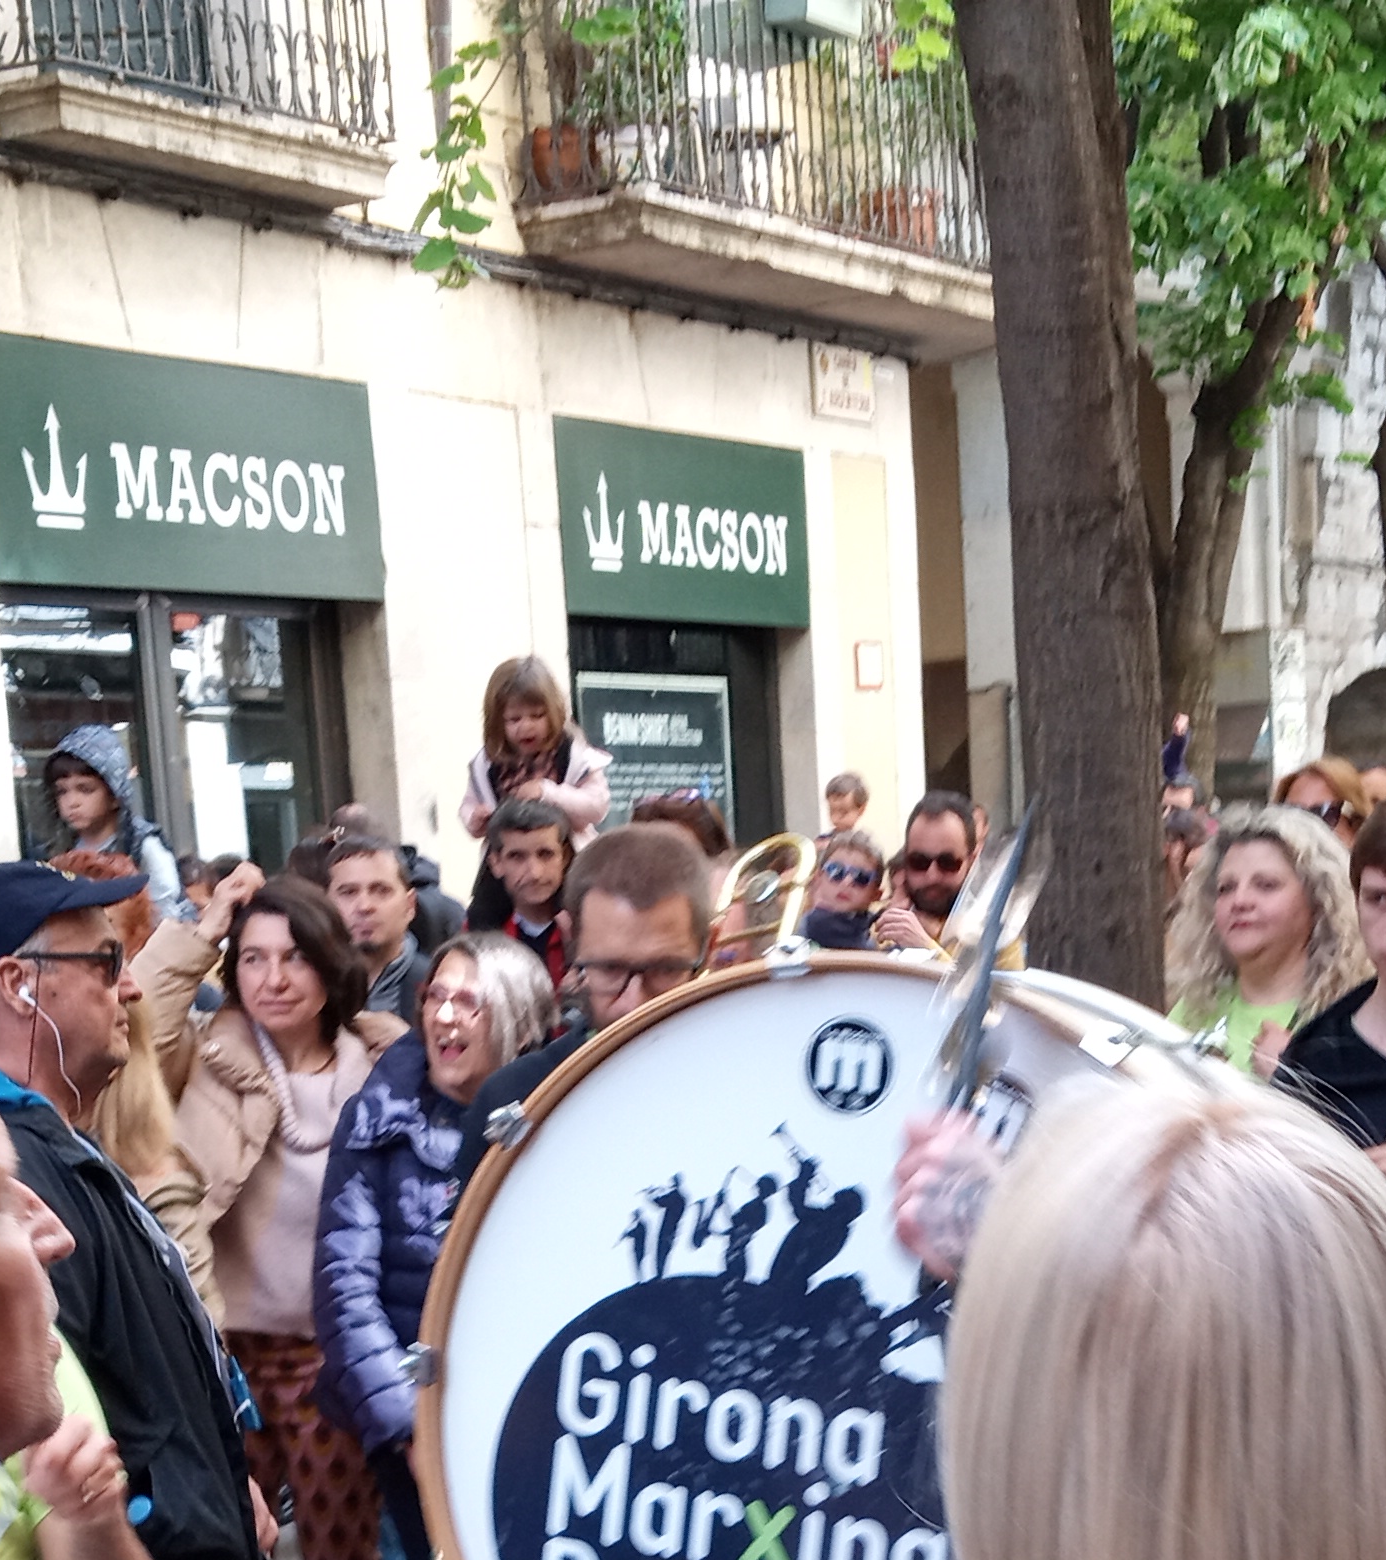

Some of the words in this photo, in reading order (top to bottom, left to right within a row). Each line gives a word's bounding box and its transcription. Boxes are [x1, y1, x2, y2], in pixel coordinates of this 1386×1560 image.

[109, 441, 346, 537] MACSON
[636, 499, 788, 576] MACSON
[557, 1332, 886, 1488] Girona
